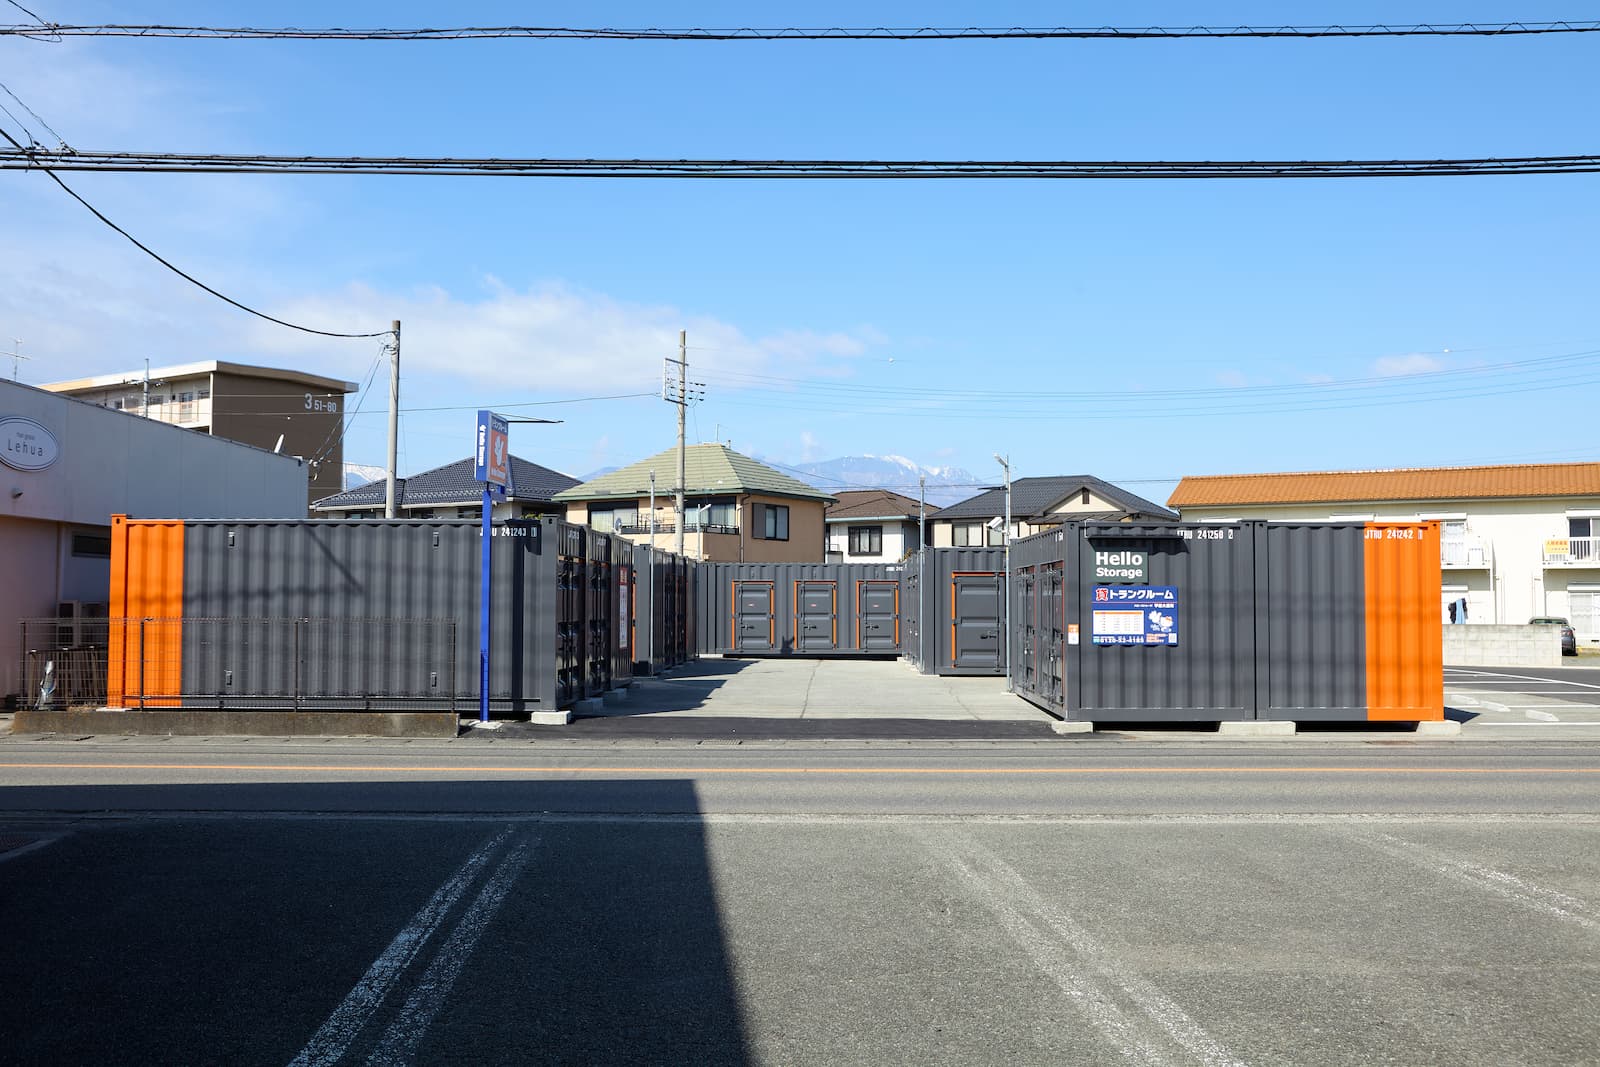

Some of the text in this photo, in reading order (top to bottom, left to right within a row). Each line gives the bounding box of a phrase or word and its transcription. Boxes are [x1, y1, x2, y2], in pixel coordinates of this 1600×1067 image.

[304, 393, 313, 409] 3
[8, 438, 43, 457] Lehua
[1365, 529, 1382, 539] JTRU
[1387, 529, 1414, 539] 241242
[1095, 552, 1143, 566] Hello
[1096, 567, 1143, 579] Storage
[1110, 589, 1174, 600] トランクルーム
